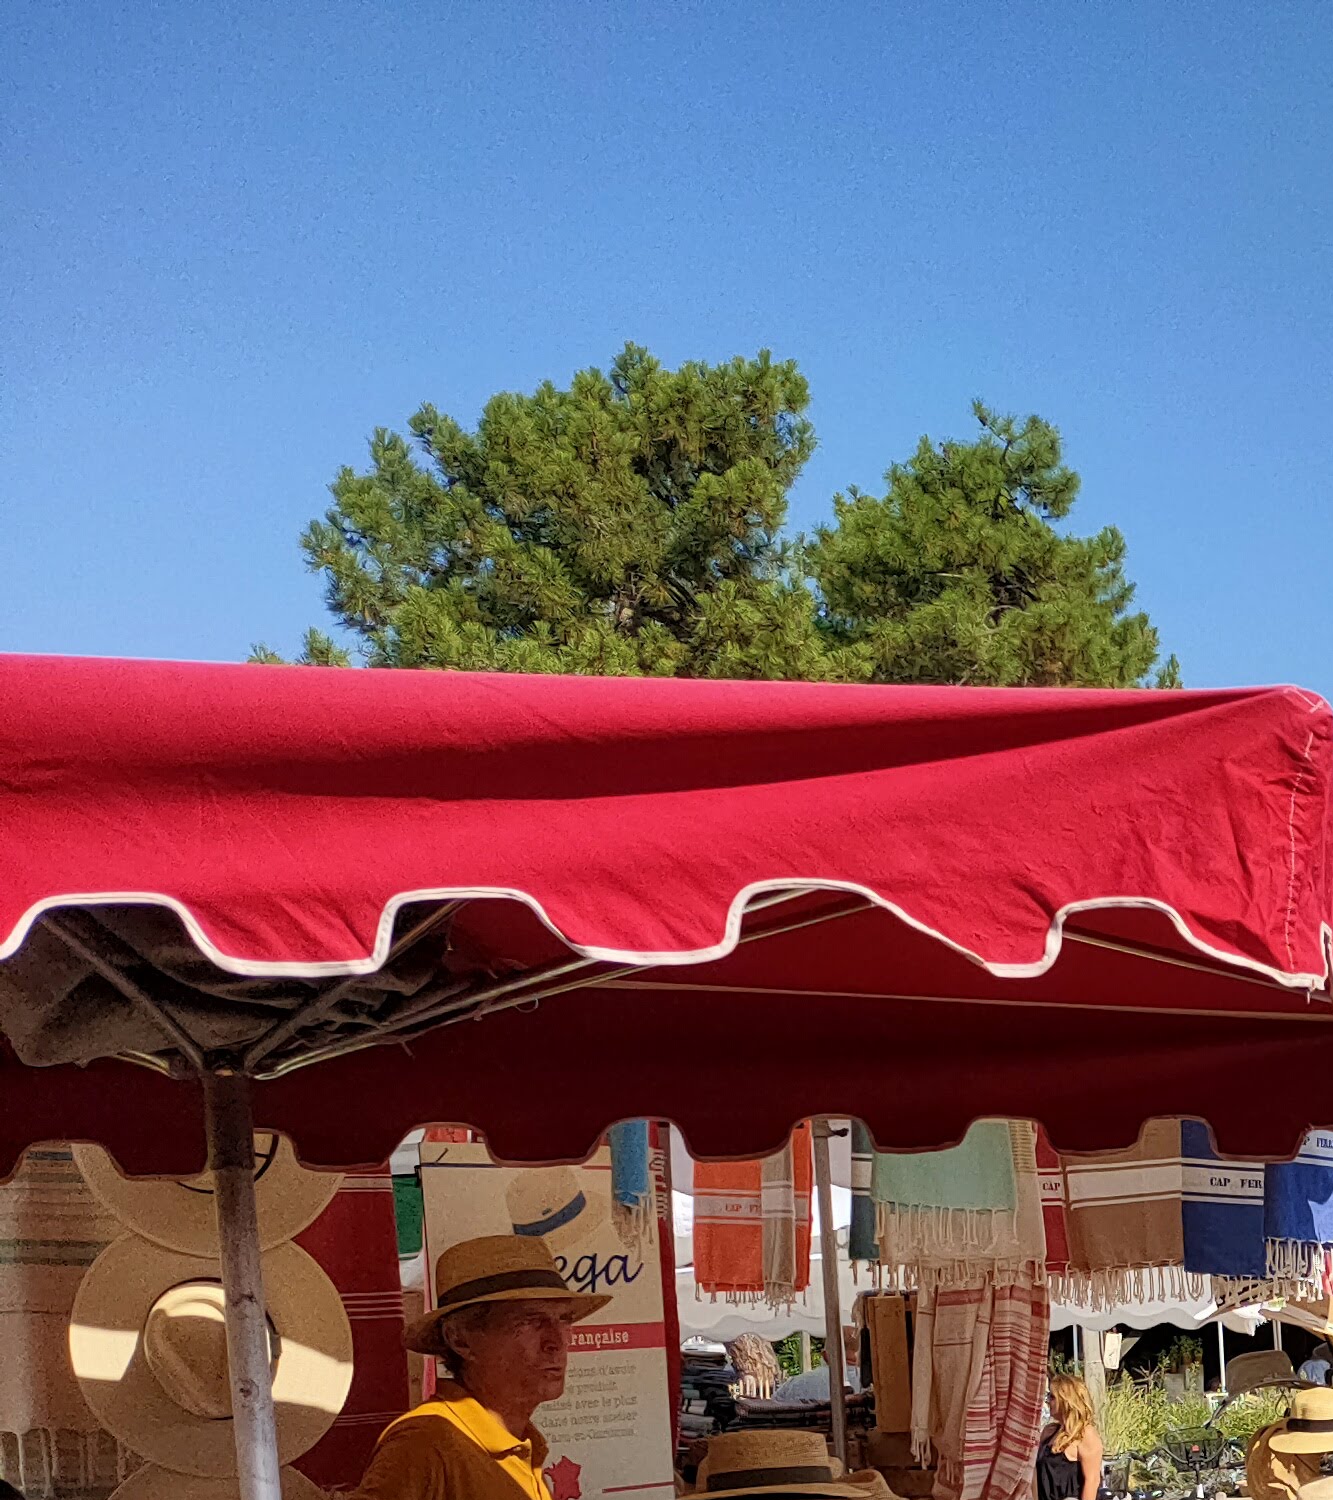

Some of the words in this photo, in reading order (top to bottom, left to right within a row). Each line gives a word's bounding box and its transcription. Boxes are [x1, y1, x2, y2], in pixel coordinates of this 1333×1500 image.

[1042, 1181, 1061, 1191] CAP
[1209, 1176, 1231, 1188] CAP
[552, 1252, 644, 1293] ega
[570, 1328, 630, 1348] rançaise
